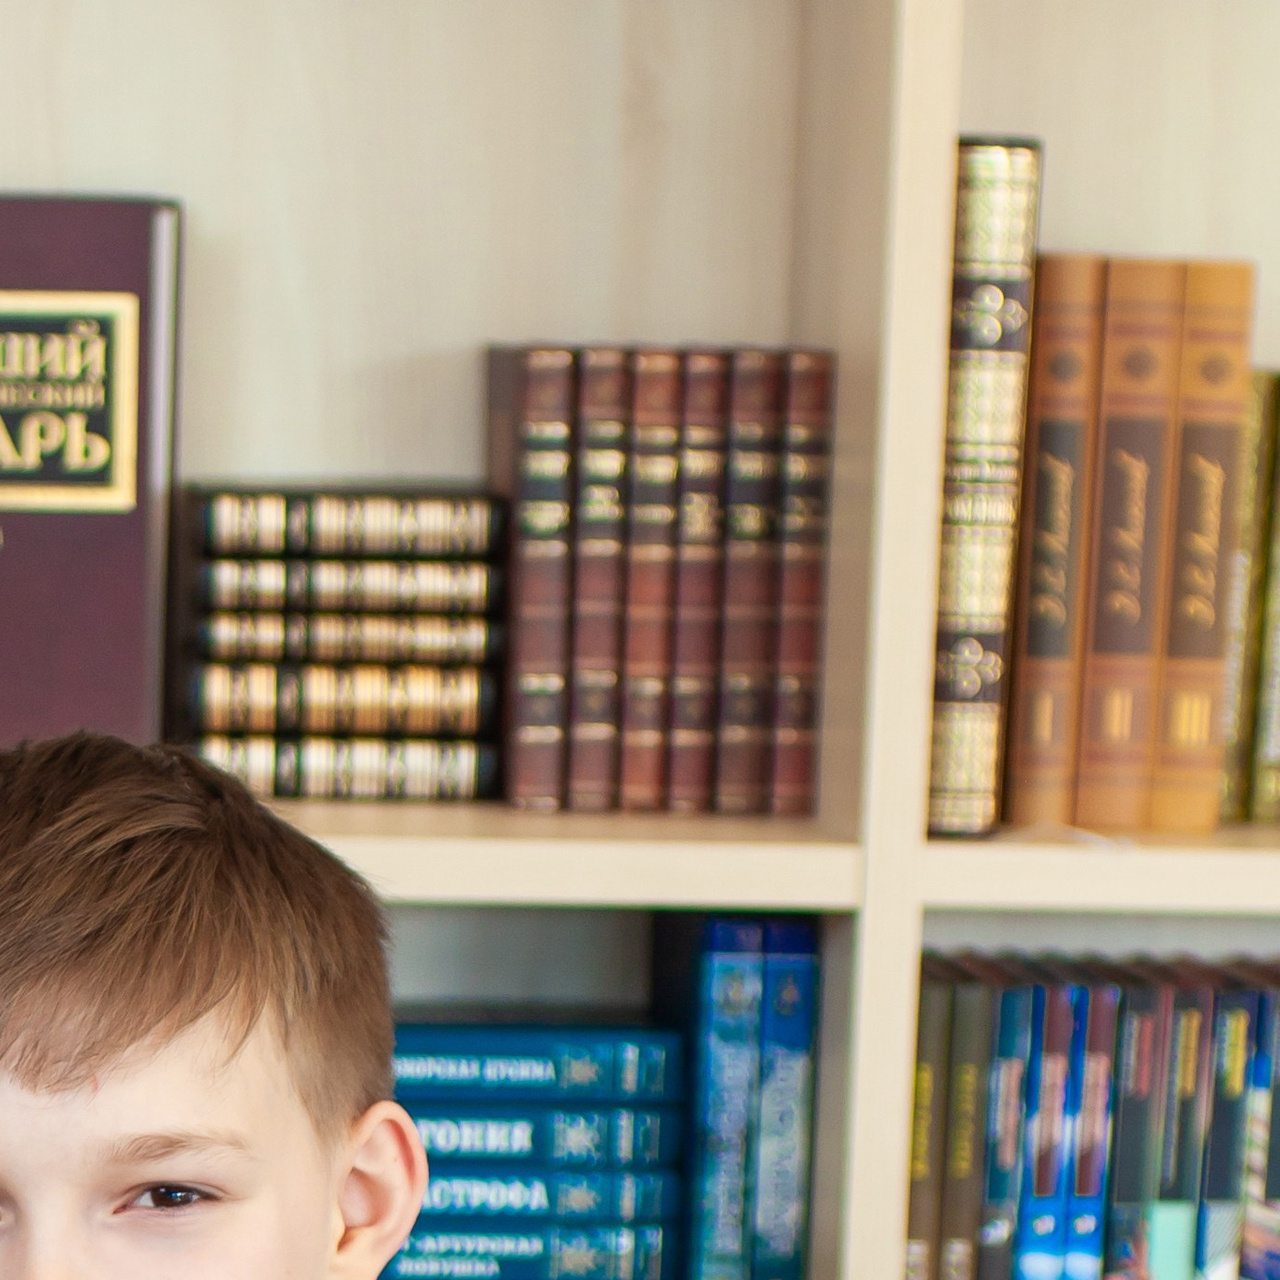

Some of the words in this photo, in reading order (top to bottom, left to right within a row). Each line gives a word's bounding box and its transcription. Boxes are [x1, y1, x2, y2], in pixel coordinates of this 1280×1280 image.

[394, 1057, 480, 1080] МОРСКАЯ
[417, 1119, 533, 1153] ГОНИЯ
[422, 1177, 550, 1211] СТРОФА
[401, 1232, 544, 1256] Т-АРТУРСКАЯ
